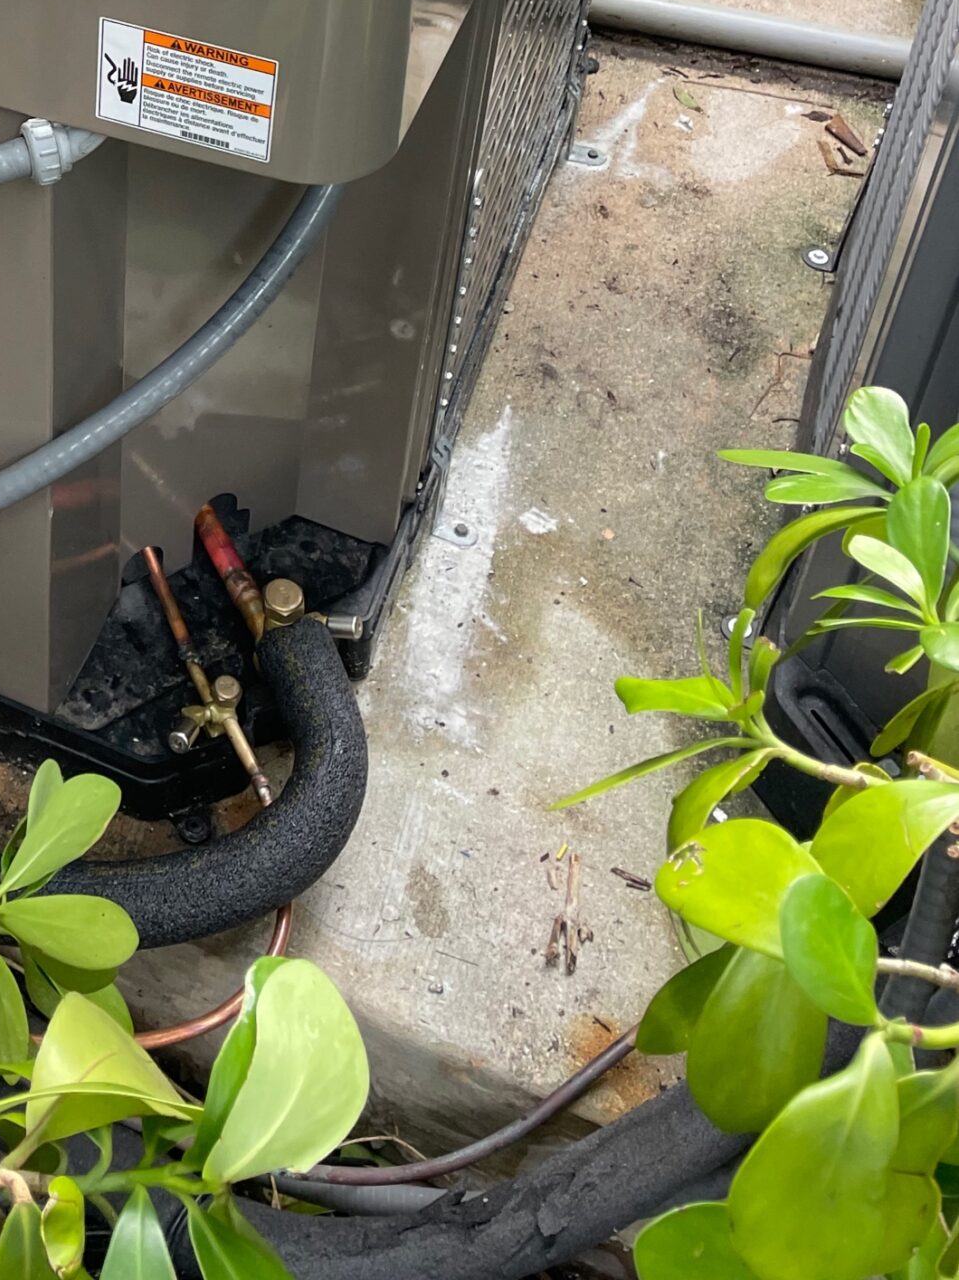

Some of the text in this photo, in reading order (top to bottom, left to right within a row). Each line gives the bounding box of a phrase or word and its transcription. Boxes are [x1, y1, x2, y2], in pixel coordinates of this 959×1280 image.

[146, 45, 160, 54] Risk
[169, 51, 194, 63] electric
[146, 52, 158, 60] Can
[159, 56, 179, 65] cause
[180, 60, 198, 72] injury
[184, 42, 249, 67] WARNING
[145, 59, 264, 97] Disconnect the remote electric power
[145, 66, 166, 77] supply
[176, 73, 202, 86] supplies
[203, 81, 225, 91] before
[143, 88, 165, 99] Risque
[175, 96, 191, 105] choc
[227, 110, 249, 121] Risque
[167, 81, 260, 114] AVERTISSEMENT
[183, 117, 211, 130] distance
[211, 125, 229, 135] avant
